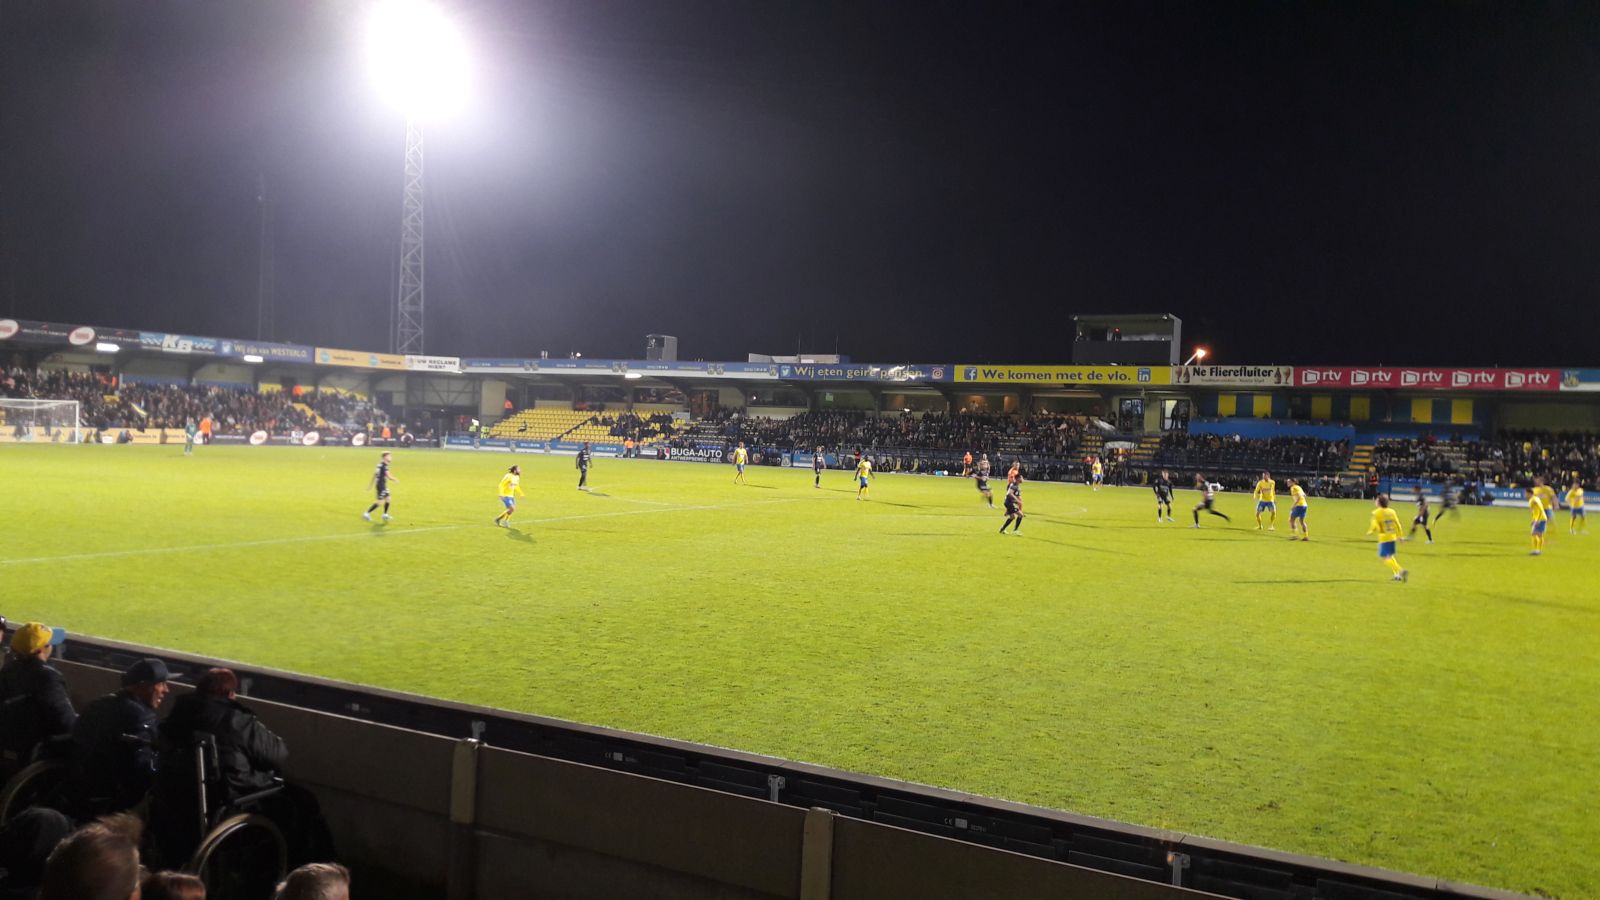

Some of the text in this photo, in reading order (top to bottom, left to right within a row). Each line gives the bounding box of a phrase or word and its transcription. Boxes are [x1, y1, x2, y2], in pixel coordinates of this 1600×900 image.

[794, 366, 815, 378] Wij
[817, 368, 842, 377] eten
[982, 369, 1131, 381] We komen met de vlo.
[1192, 366, 1273, 377] Ne Flierefluiter
[1322, 370, 1342, 381] rtv
[1372, 370, 1392, 382] rtv
[1422, 370, 1442, 382] rtv
[1474, 371, 1495, 383] rtv
[1528, 371, 1550, 384] rtv
[671, 447, 723, 458] BUGA-AUTO
